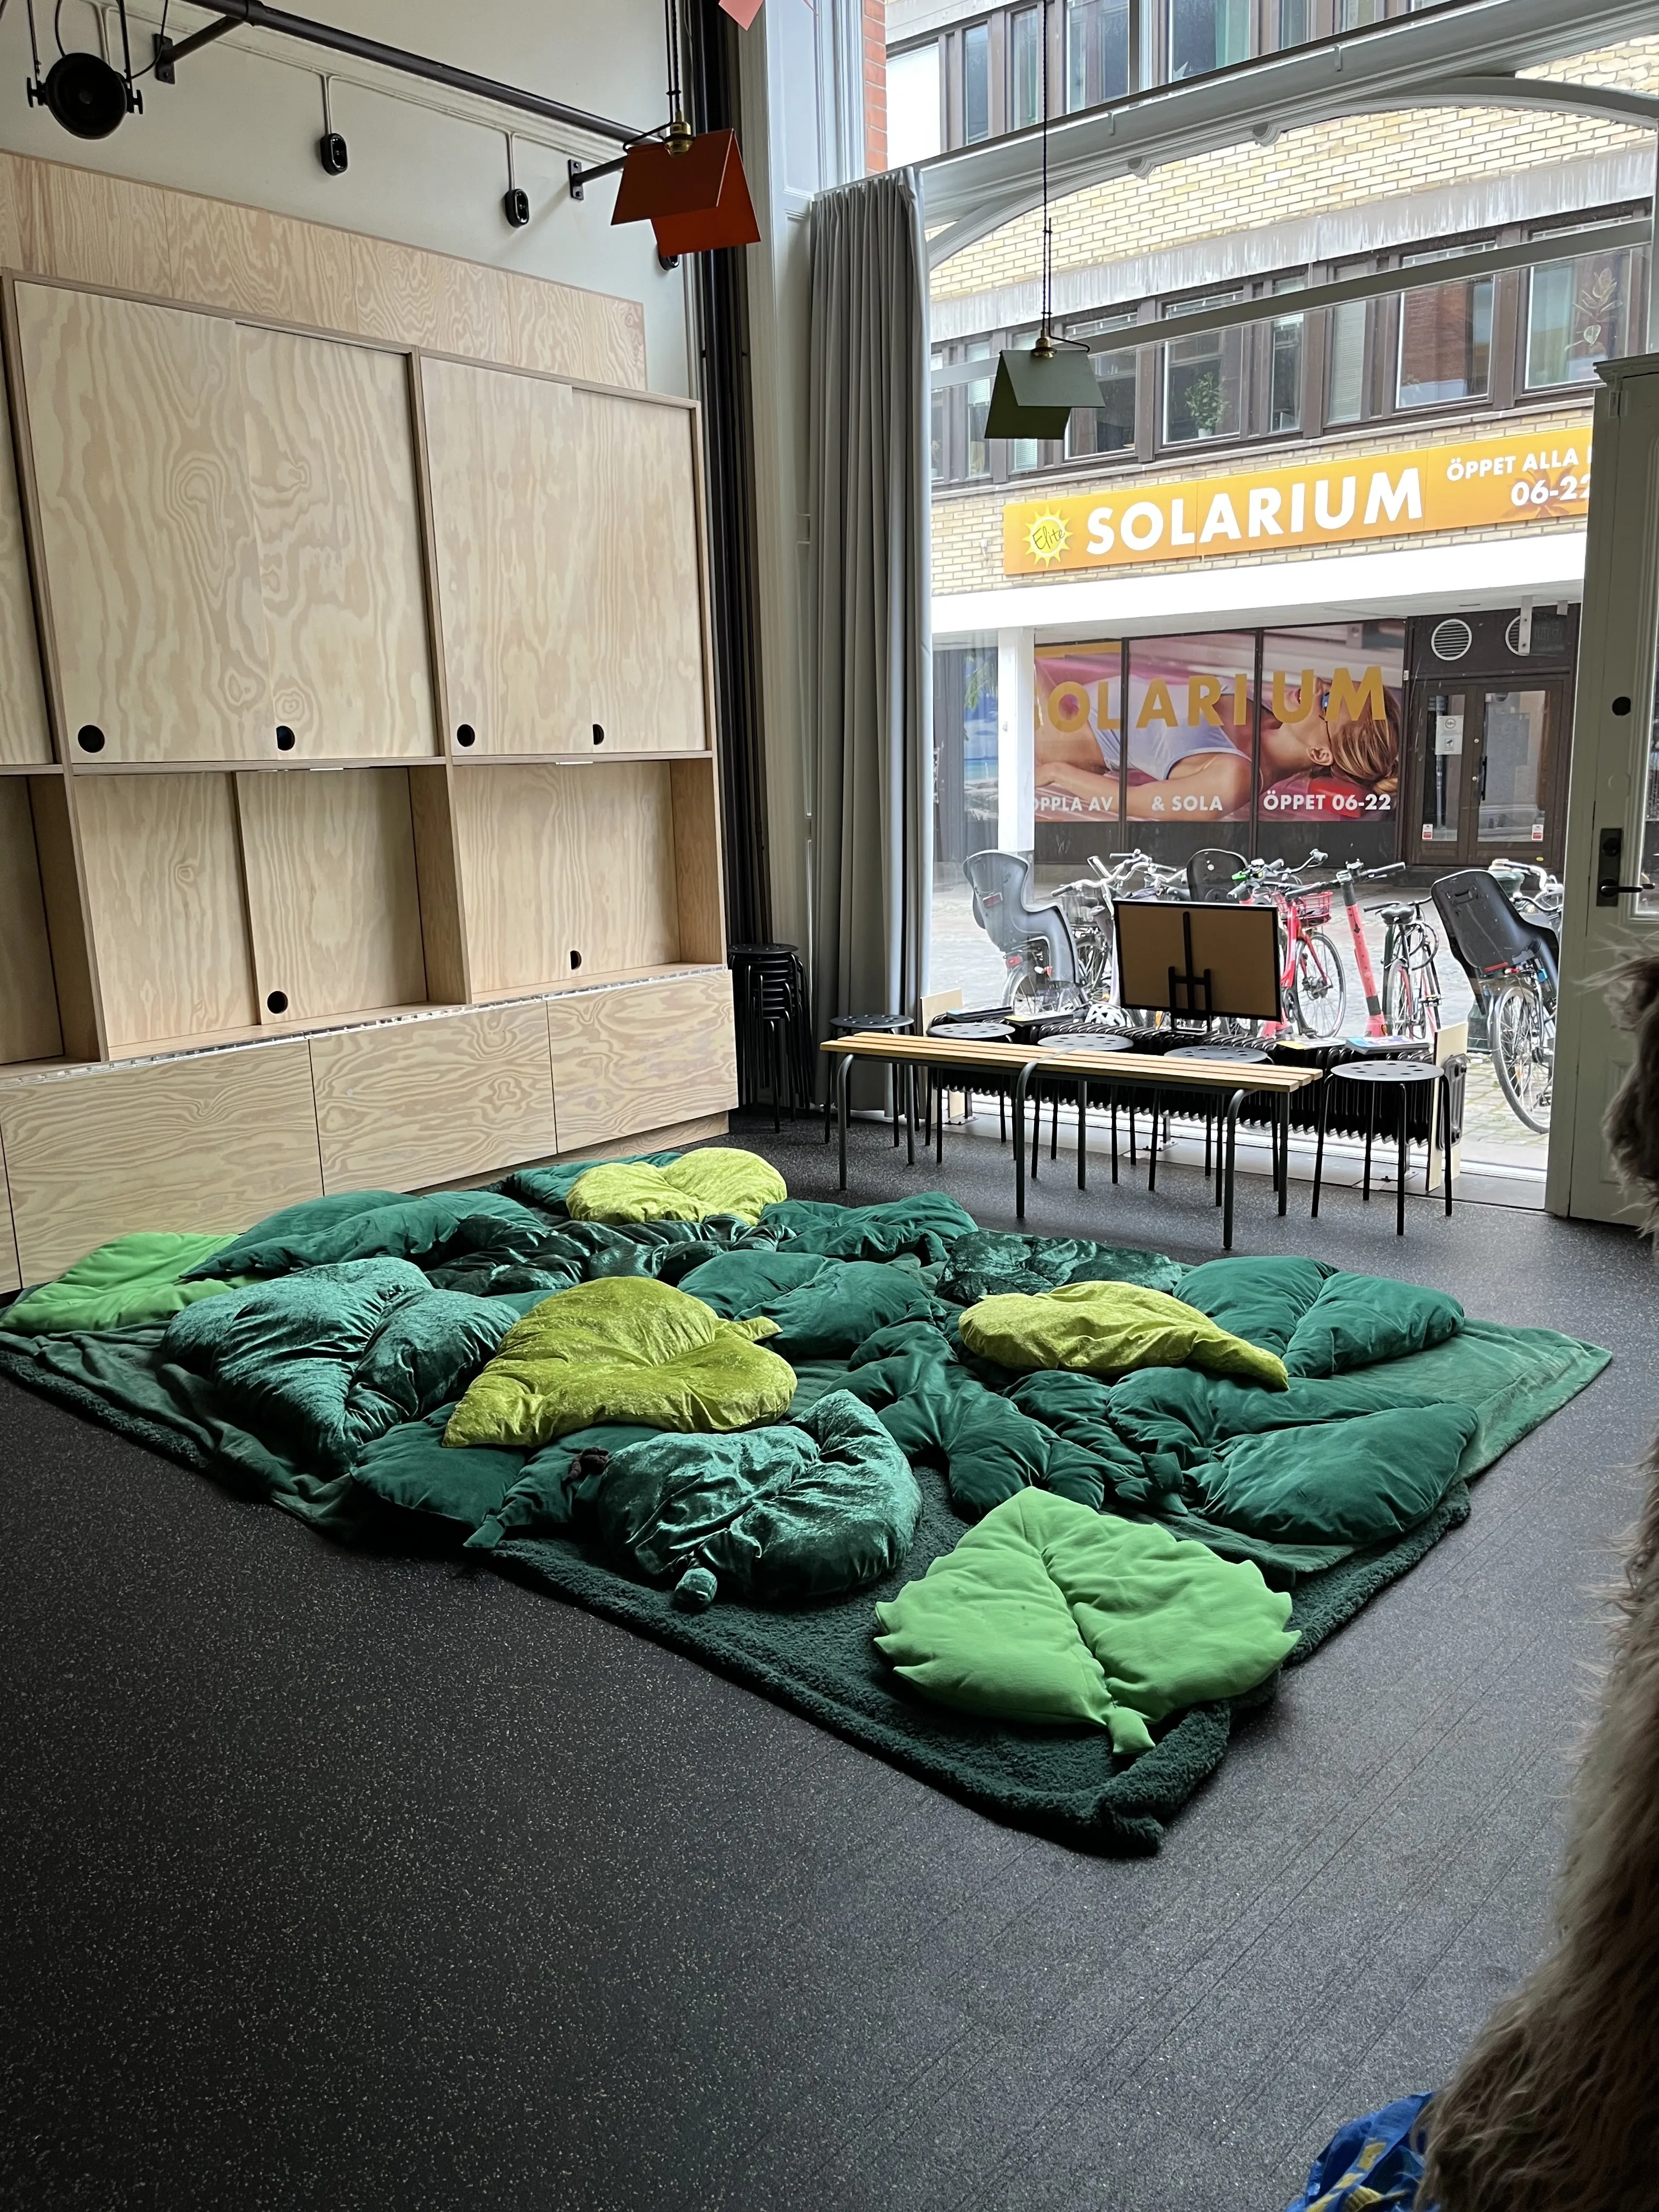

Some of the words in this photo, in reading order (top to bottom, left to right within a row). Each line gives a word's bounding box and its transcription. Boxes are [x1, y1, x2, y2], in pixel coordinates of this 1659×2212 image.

[1447, 456, 1516, 481] ÖPPET
[1522, 448, 1579, 471] ALLA
[1086, 467, 1422, 555] SOLARIUM
[1032, 527, 1065, 550] Elite
[1034, 667, 1386, 732] OLARIUM
[1088, 796, 1113, 811] AV
[1152, 796, 1165, 811] &
[1172, 795, 1223, 811] SOLA
[1263, 790, 1326, 810] ÖPPET
[1332, 794, 1391, 810] 06-22
